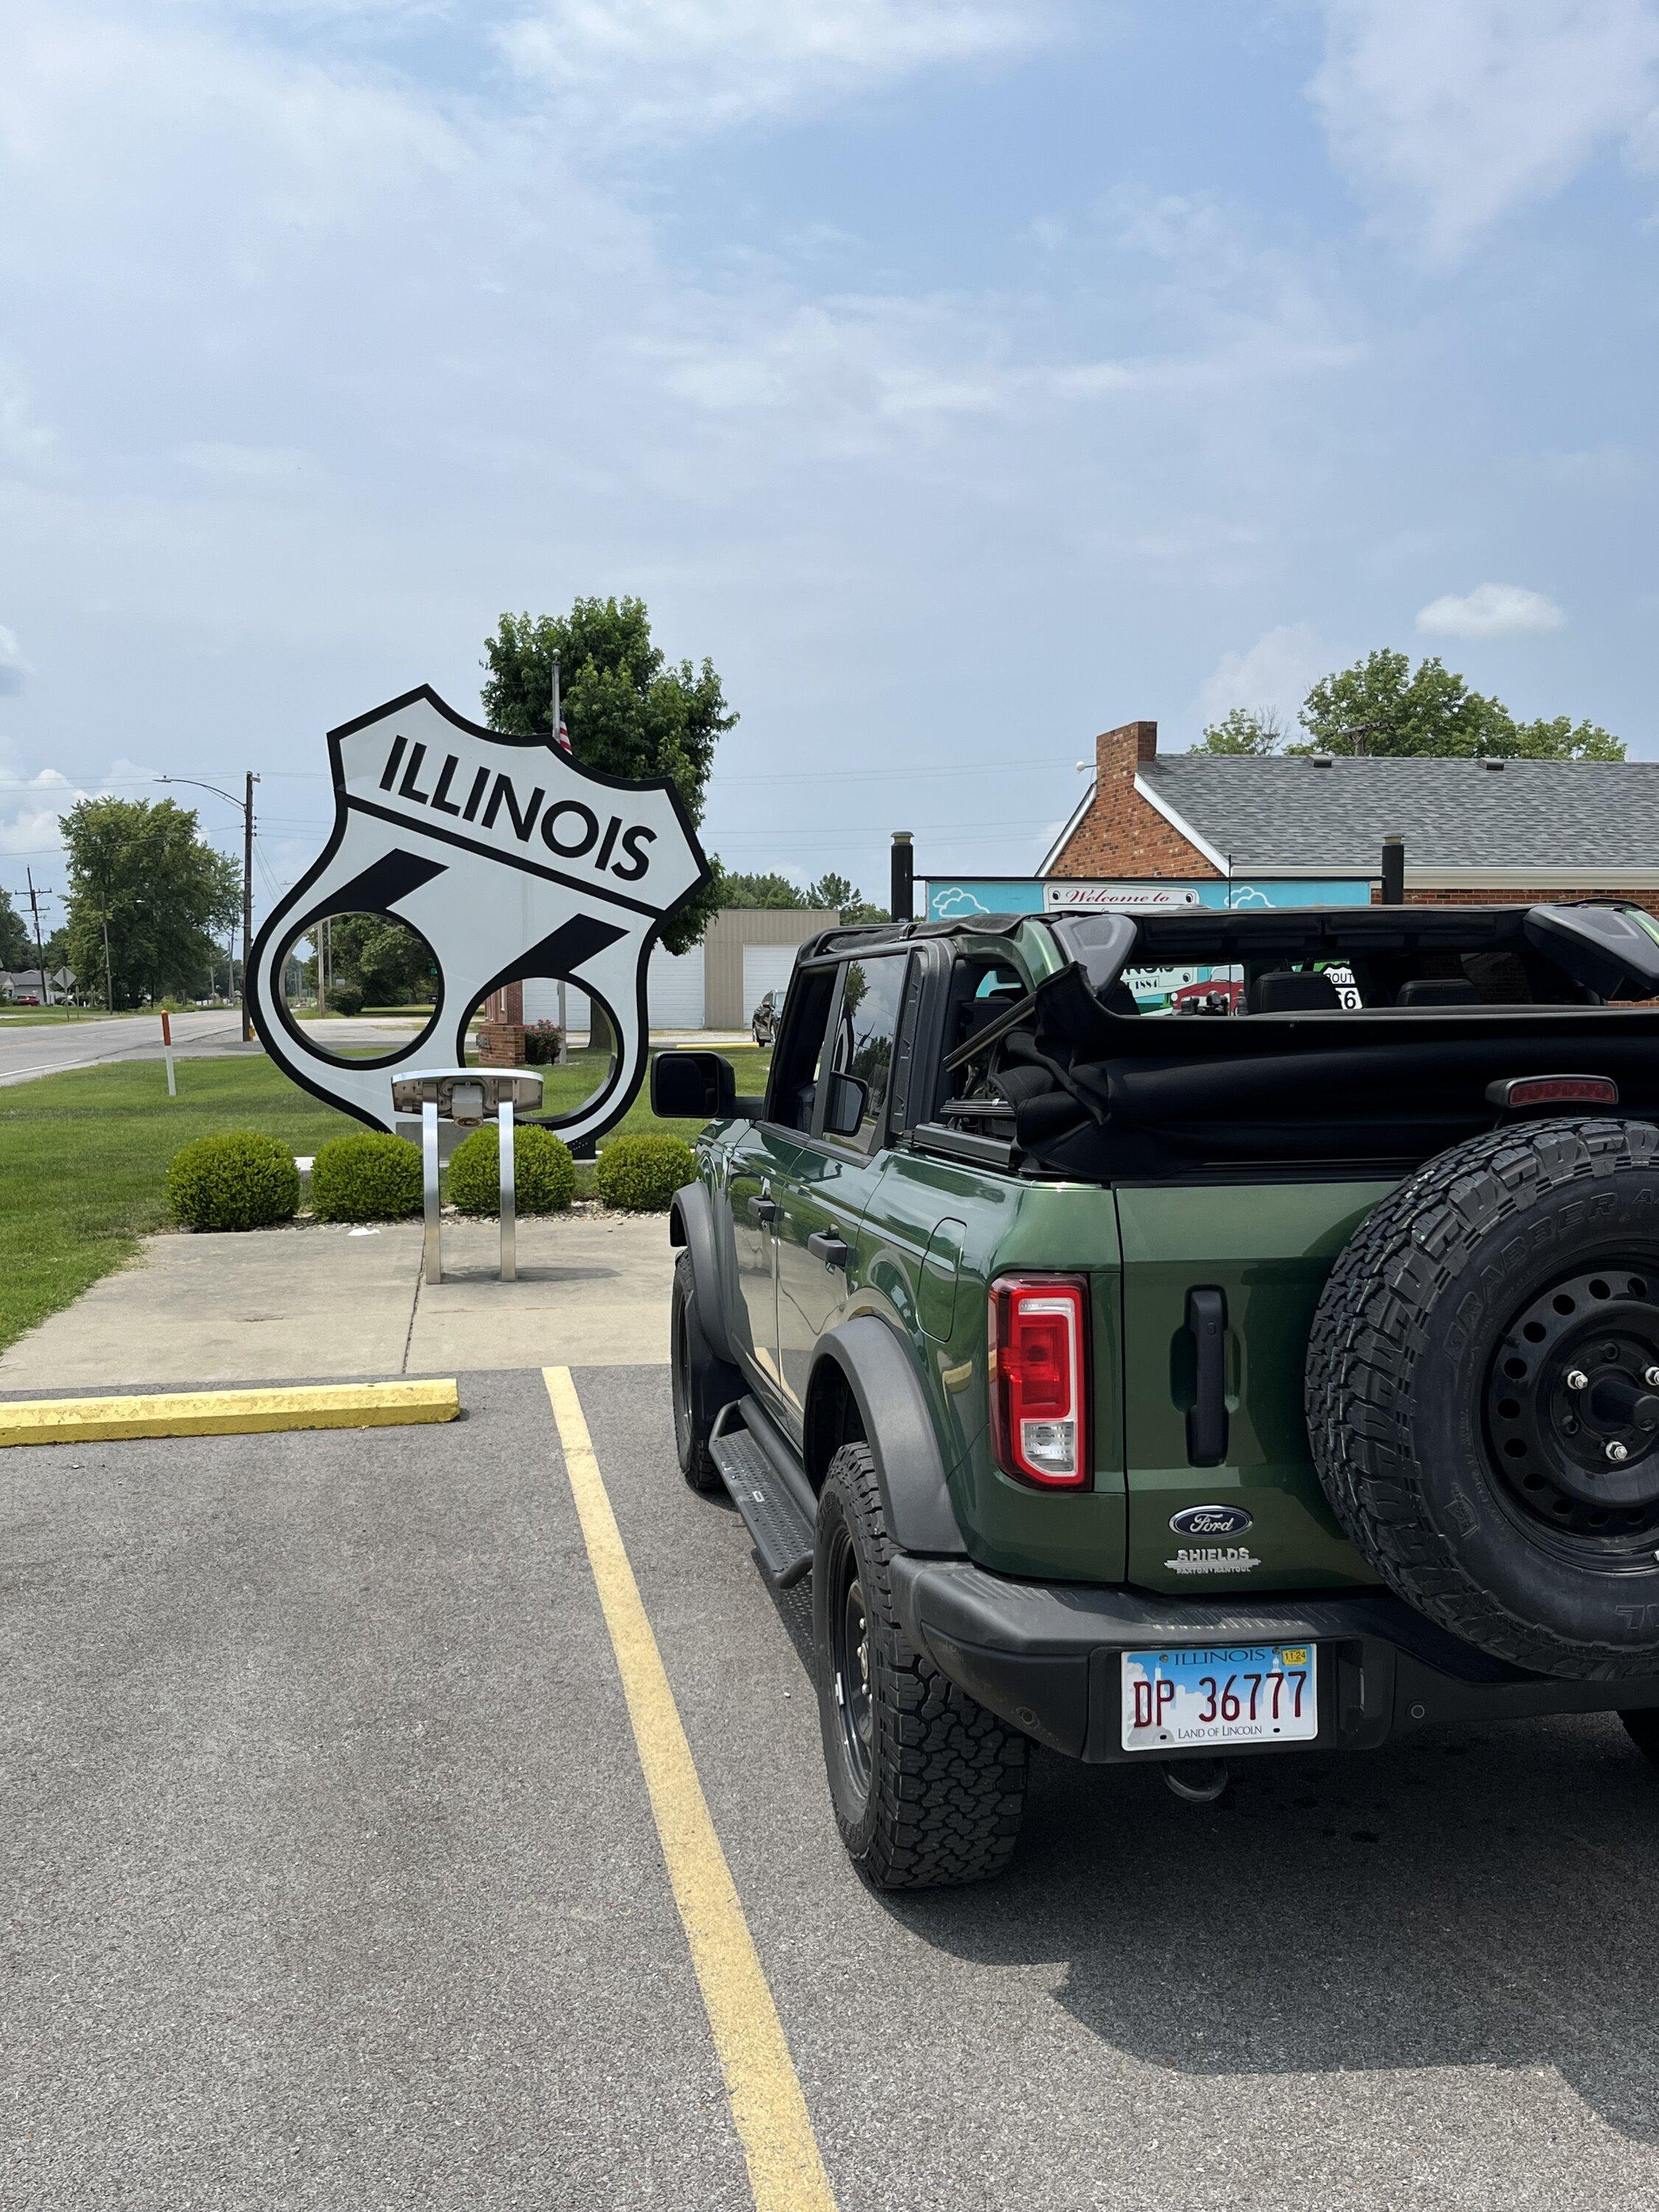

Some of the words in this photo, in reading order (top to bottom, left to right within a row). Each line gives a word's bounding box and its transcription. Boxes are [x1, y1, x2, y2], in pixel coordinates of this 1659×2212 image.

[379, 735, 658, 881] ILLINOIS
[1066, 889, 1148, 903] Welcome
[1152, 891, 1171, 902] to
[1443, 1192, 1617, 1364] GRABBER
[1189, 1514, 1234, 1532] Ford
[1178, 1547, 1250, 1562] SHIELDS
[1175, 1649, 1265, 1666] ILLINOIS
[1133, 1680, 1175, 1728] DP
[1199, 1671, 1307, 1722] 36777
[1178, 1728, 1205, 1739] LAND
[1207, 1727, 1219, 1736] OF
[1222, 1725, 1262, 1736] LINCOLN
